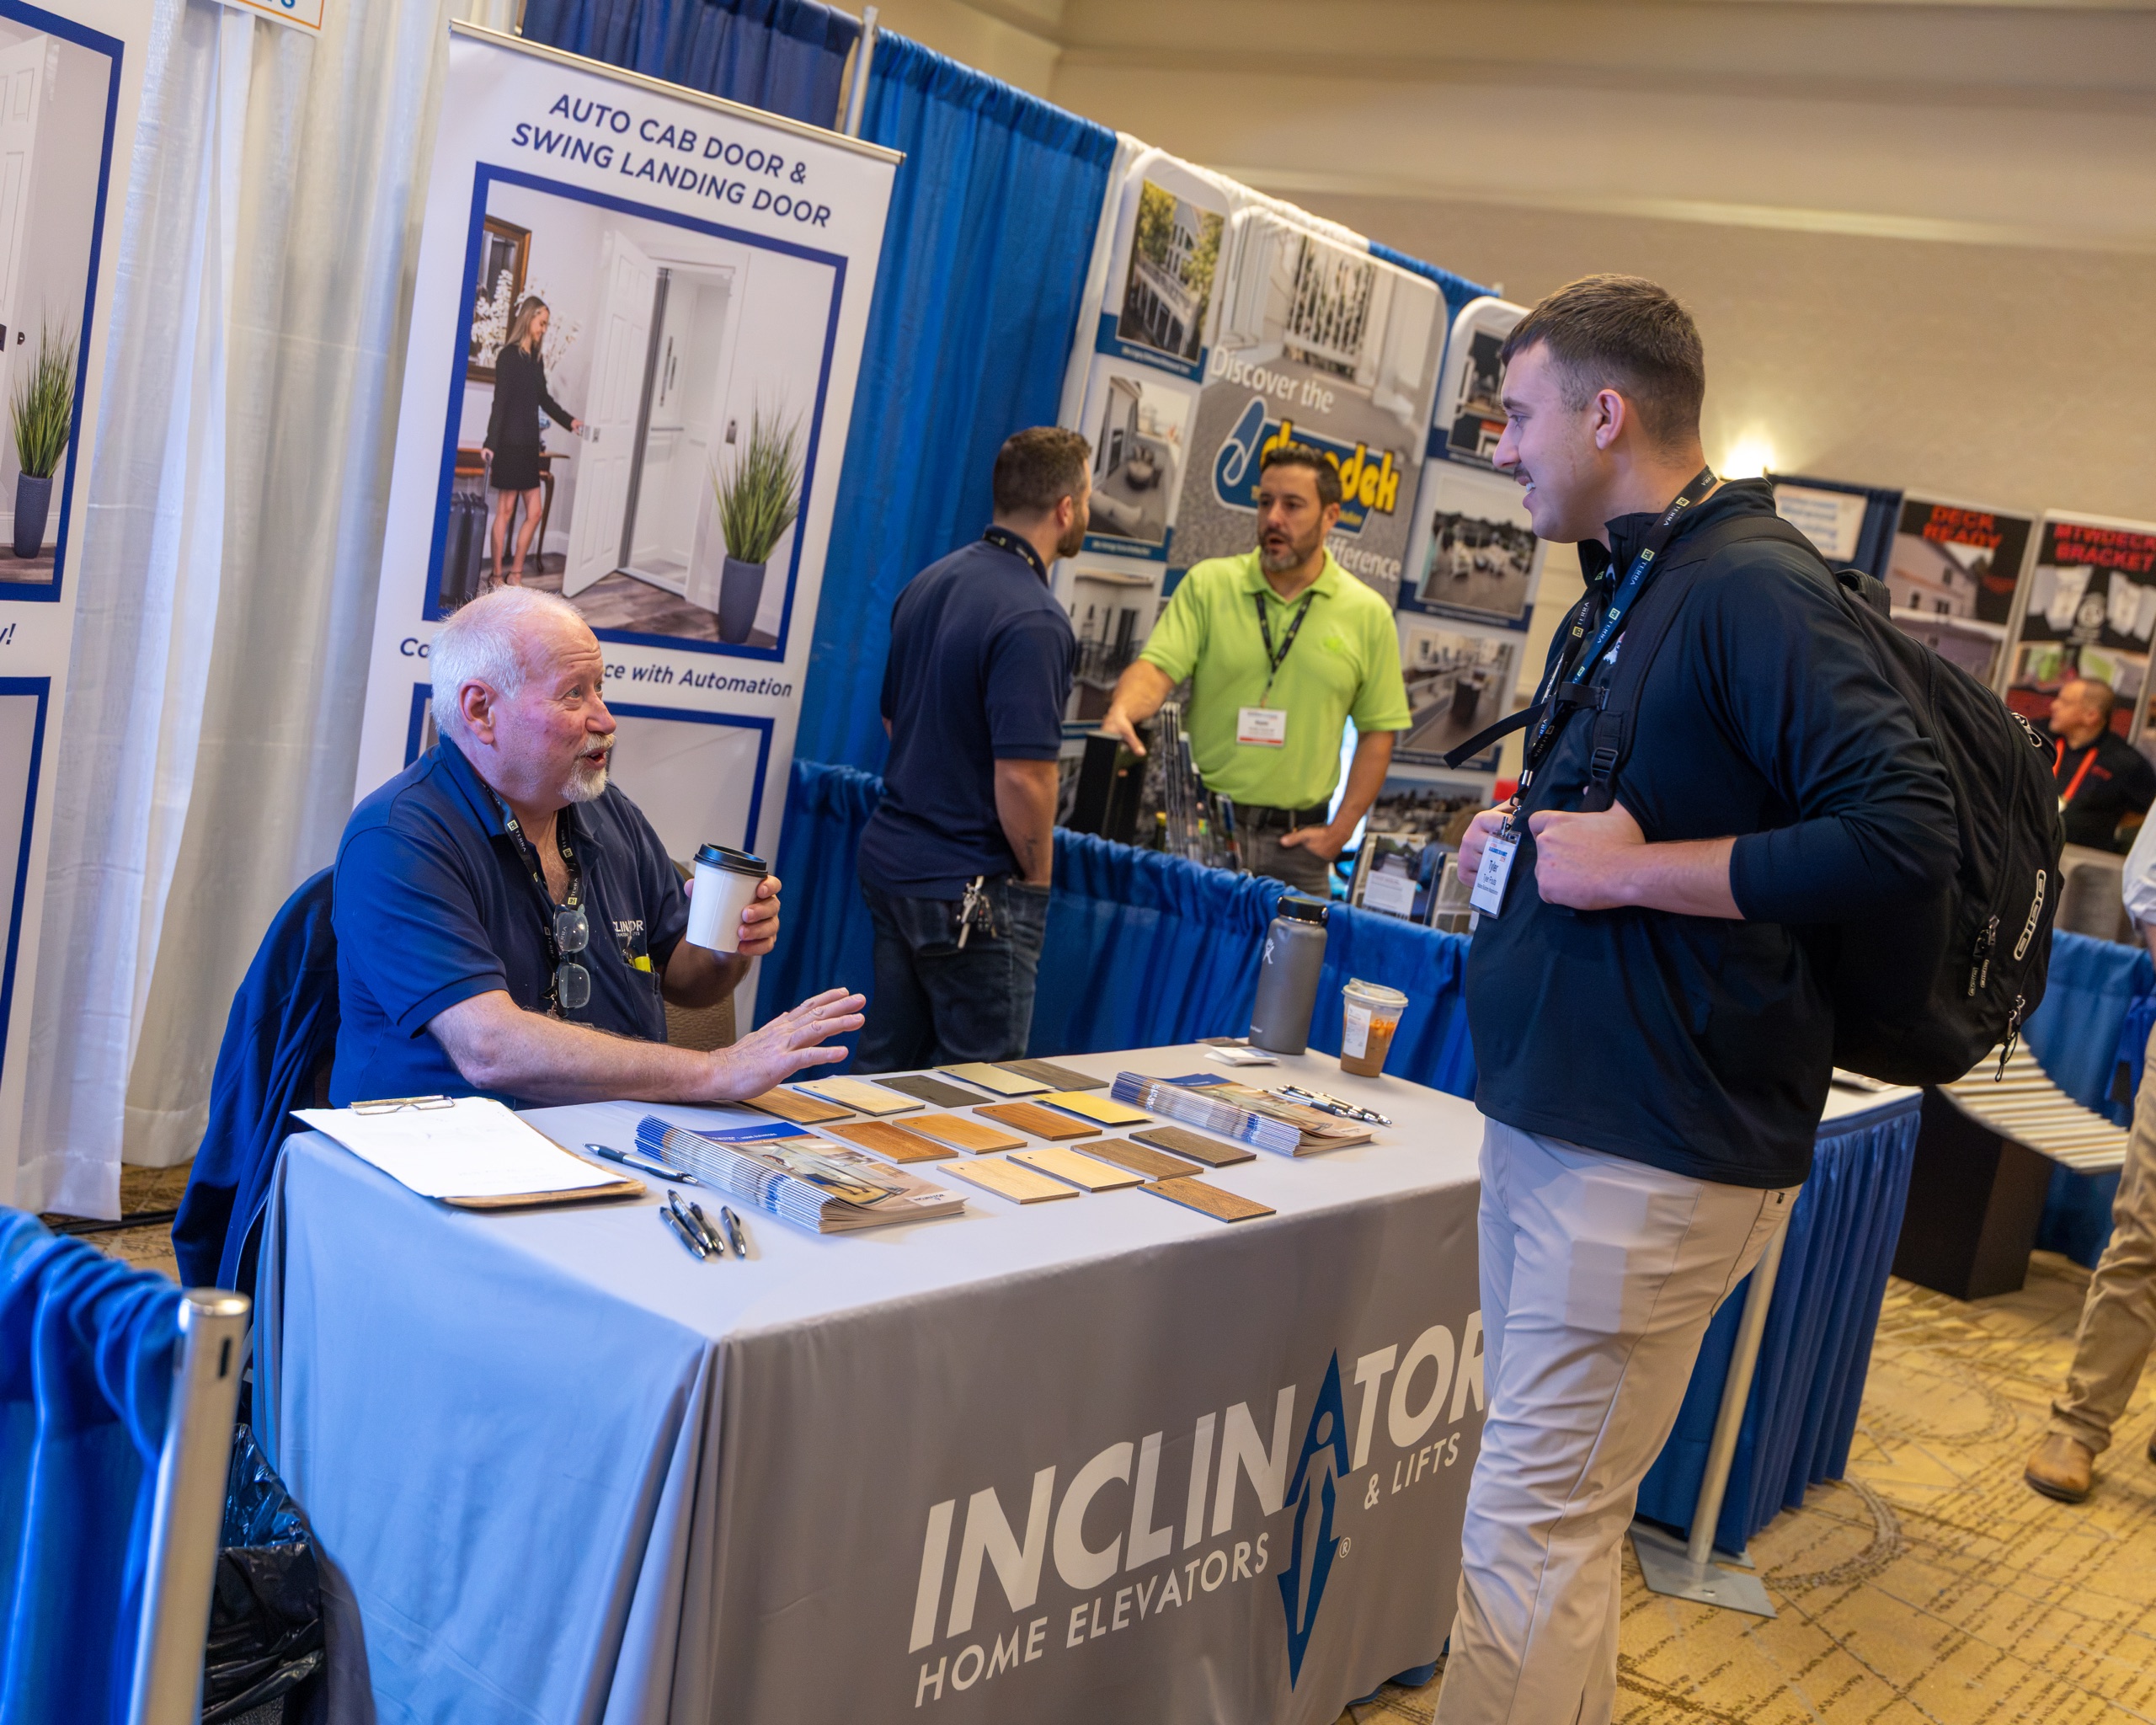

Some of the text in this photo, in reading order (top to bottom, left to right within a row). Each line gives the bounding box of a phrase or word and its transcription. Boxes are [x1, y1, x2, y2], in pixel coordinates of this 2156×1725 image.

[549, 93, 807, 184] AUTO CAB DOOR &
[511, 123, 831, 227] SWING LANDING DOOR
[1210, 344, 1299, 401] Discover
[1300, 379, 1334, 414] the
[1923, 522, 2003, 550] READY
[1630, 561, 1648, 585] TERRA
[2056, 542, 2154, 572] BRACKET
[1577, 601, 1590, 625] TERRA
[1597, 620, 1614, 644] TERRA
[632, 664, 674, 684] with
[679, 669, 792, 697] Automation
[515, 830, 526, 852] TERRA
[909, 1309, 1485, 1654] INCLINATOR
[1364, 1432, 1461, 1510] & LIFTS
[915, 1616, 1049, 1708] HOME
[1066, 1532, 1269, 1649] ELEVATORS
